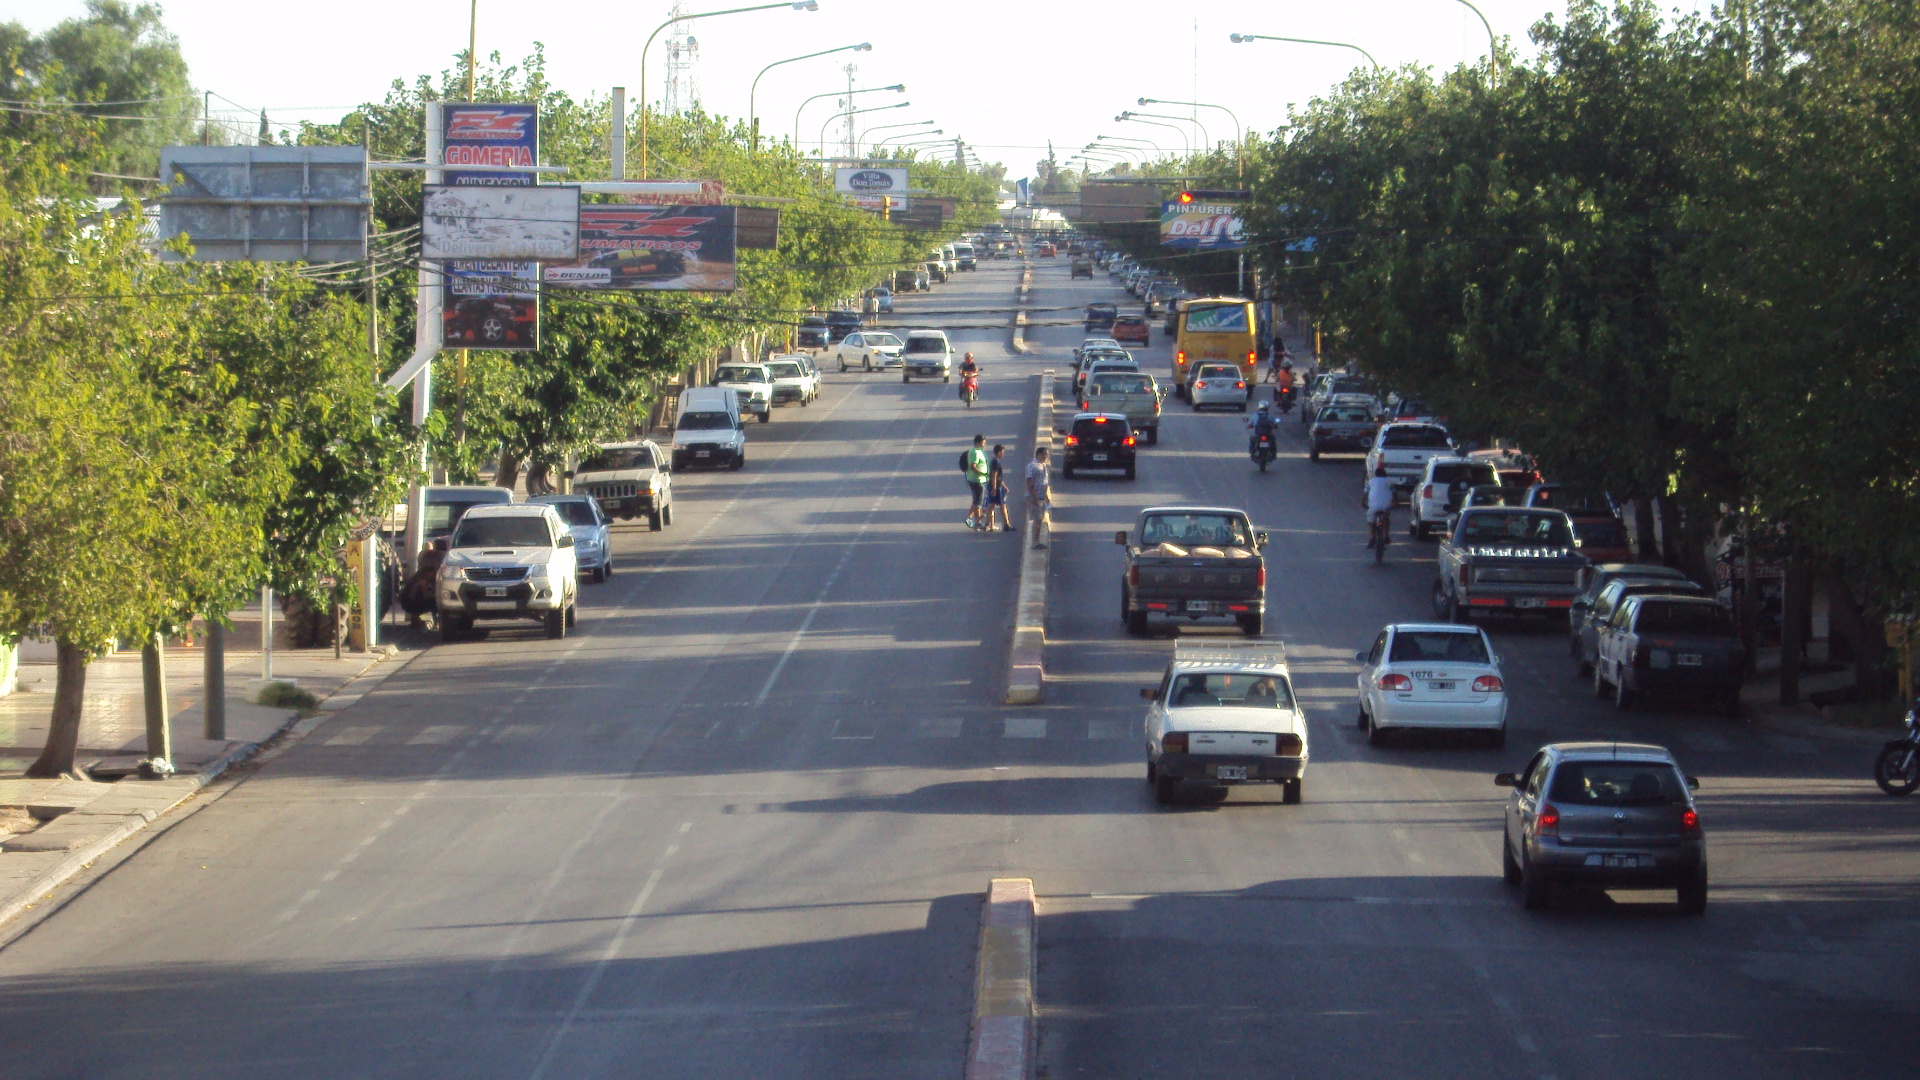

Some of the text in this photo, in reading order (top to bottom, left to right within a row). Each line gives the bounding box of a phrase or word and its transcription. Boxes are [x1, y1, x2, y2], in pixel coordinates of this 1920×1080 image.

[445, 145, 533, 166] GOMERIA
[1168, 204, 1237, 215] PINTURER
[580, 238, 703, 251] UMATICOS
[559, 271, 609, 279] DUNLOP
